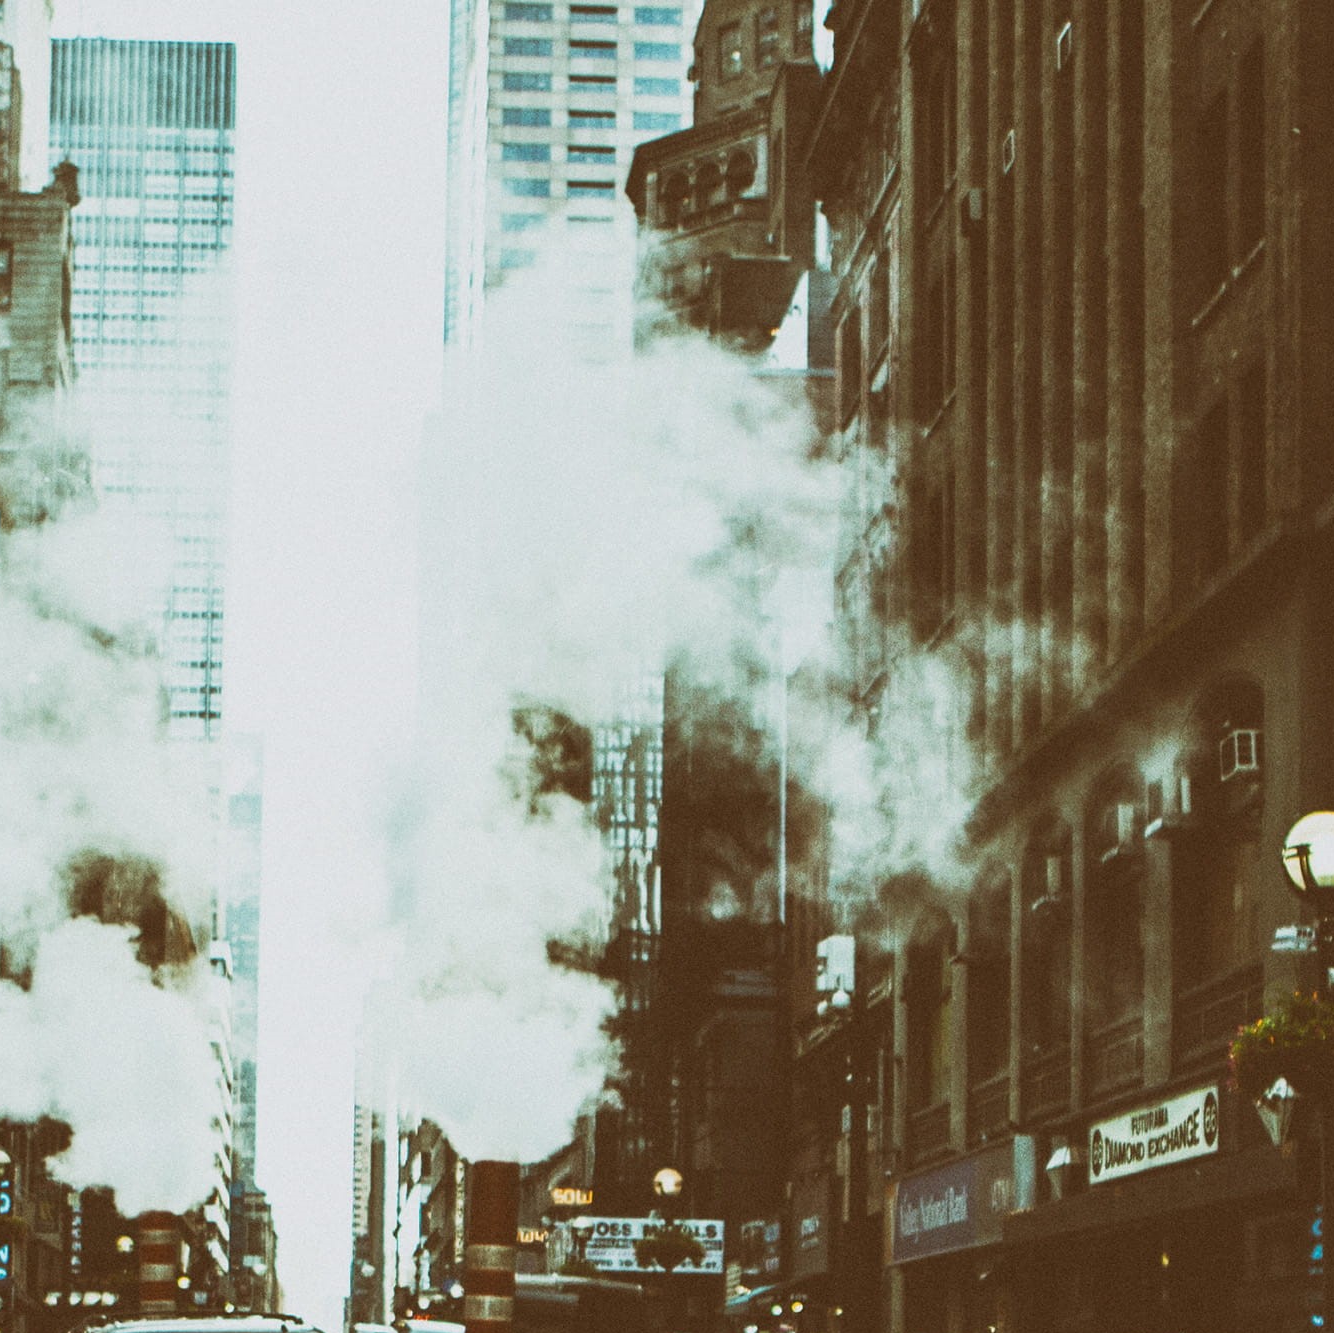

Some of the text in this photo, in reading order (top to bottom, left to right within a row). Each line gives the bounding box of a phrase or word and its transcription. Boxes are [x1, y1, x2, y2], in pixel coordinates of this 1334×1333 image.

[1104, 1108, 1200, 1170] DIAMOND EXCHANGE
[593, 1222, 632, 1238] OSS
